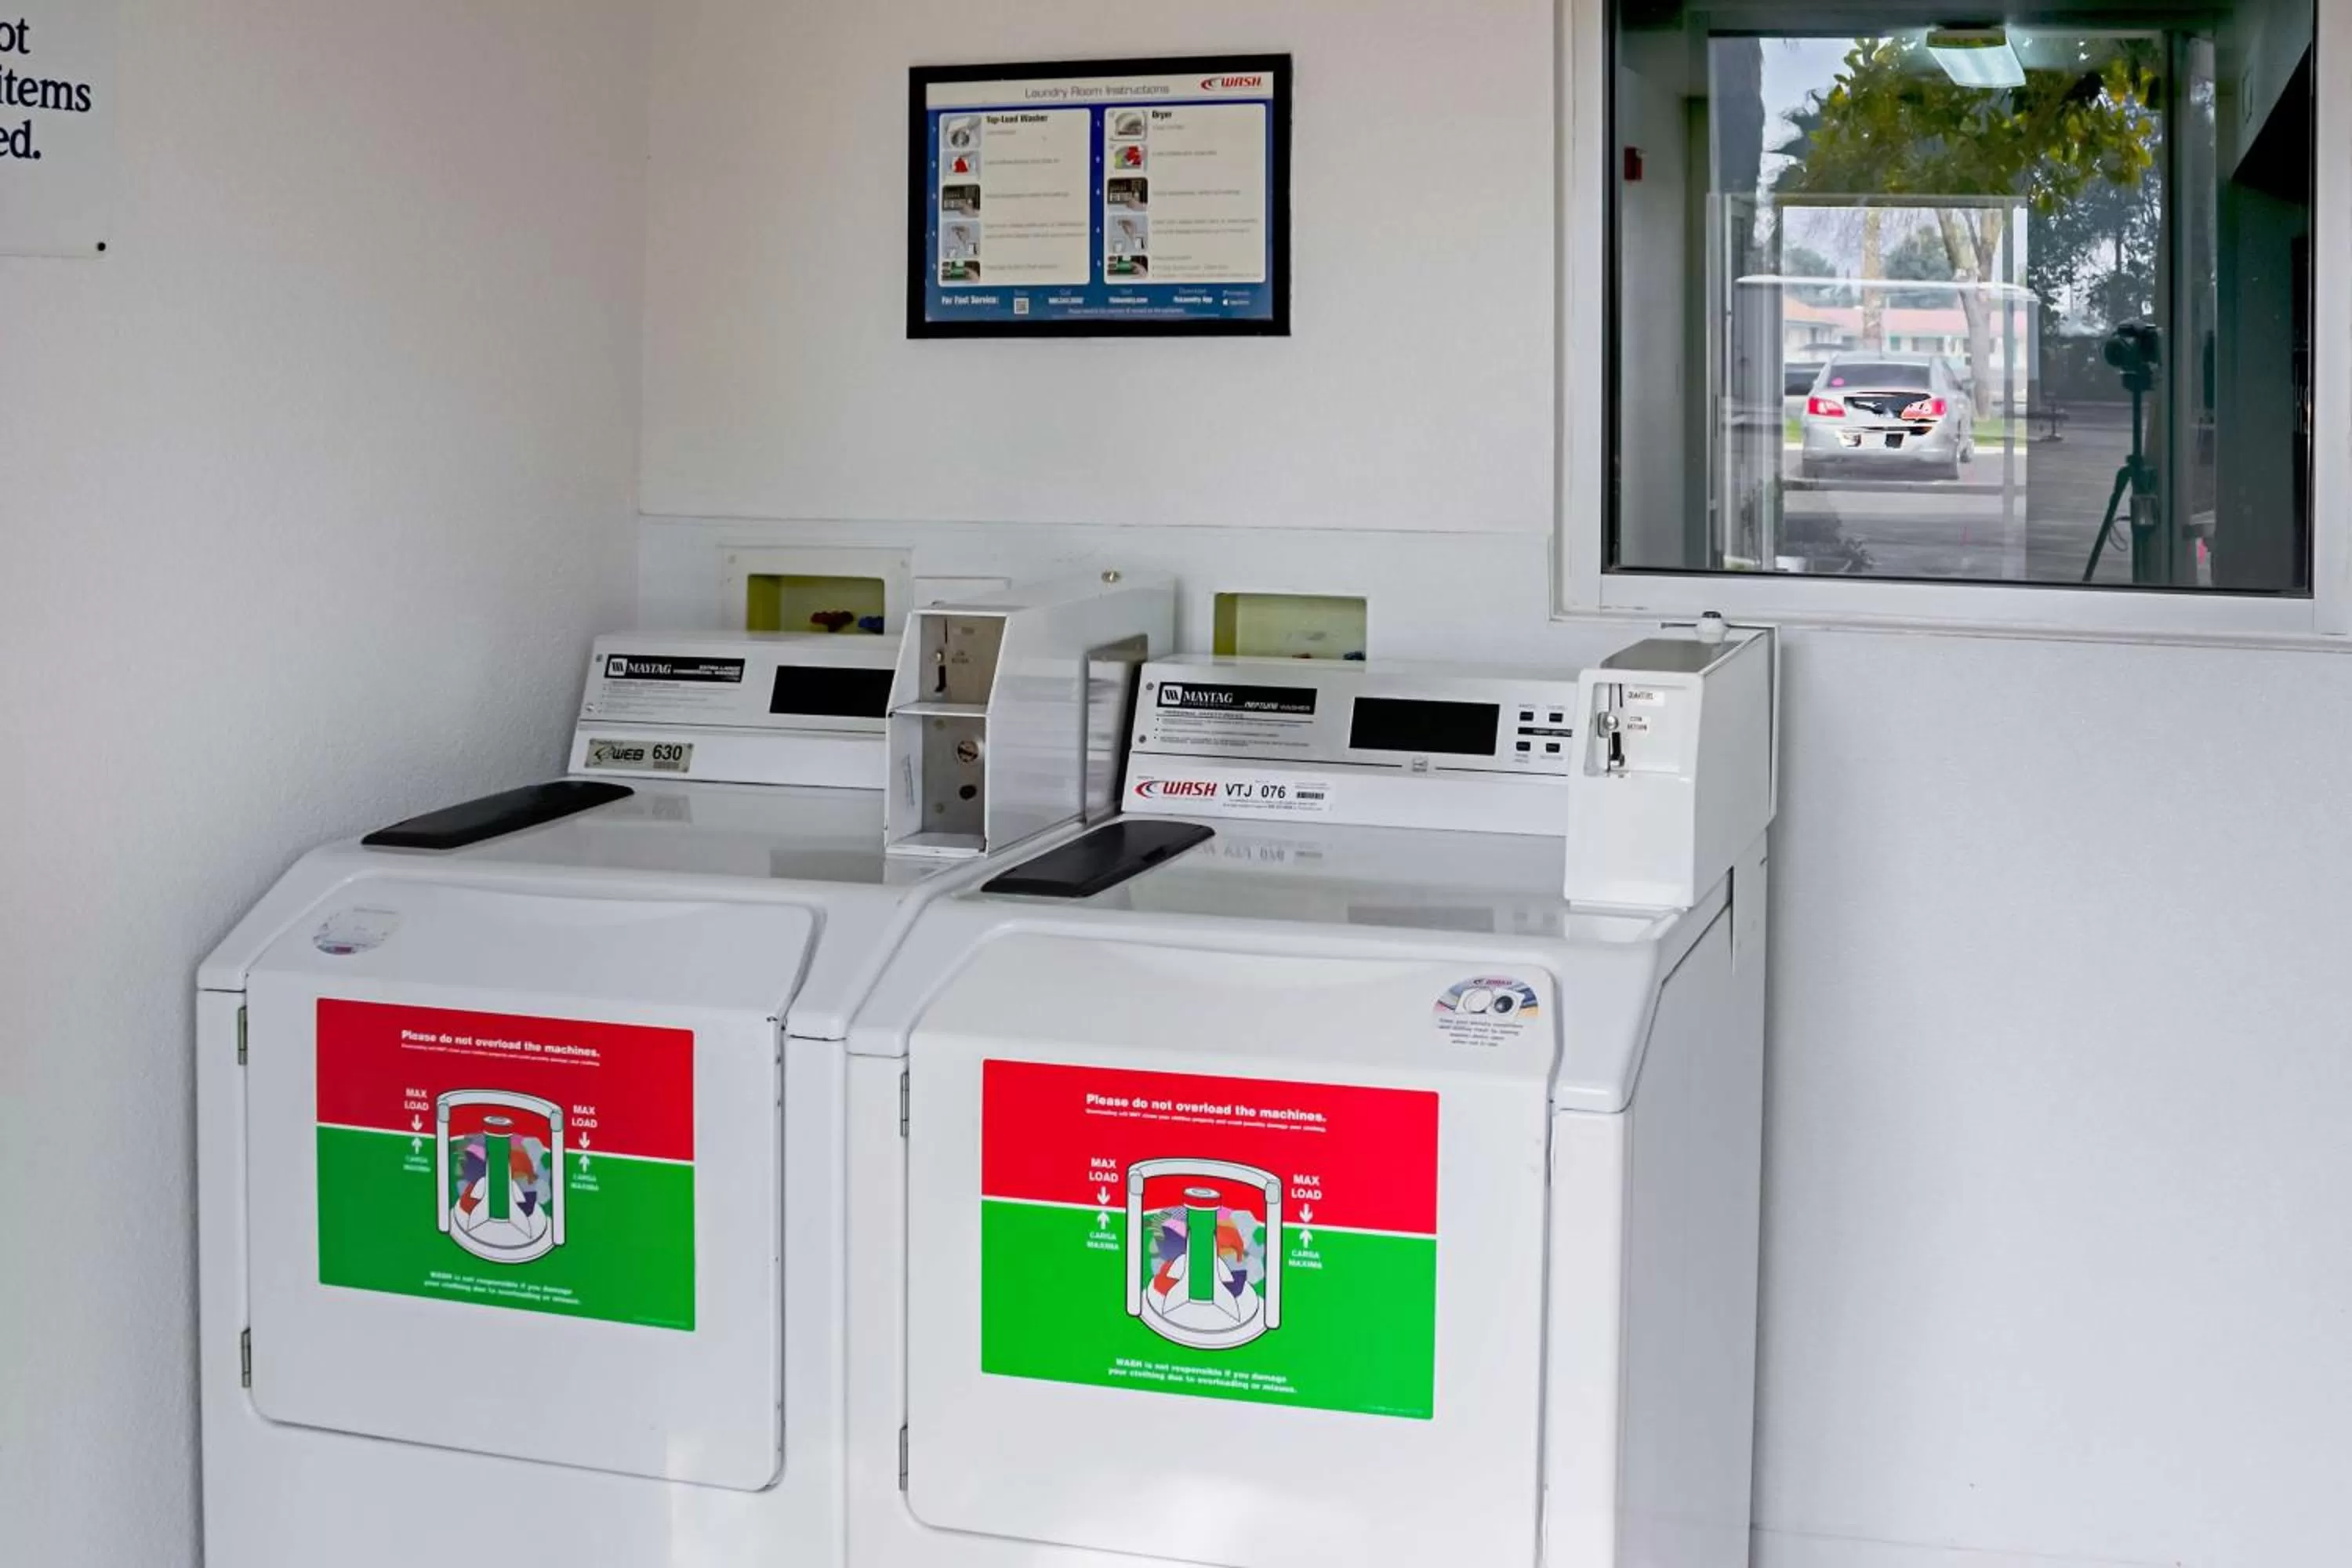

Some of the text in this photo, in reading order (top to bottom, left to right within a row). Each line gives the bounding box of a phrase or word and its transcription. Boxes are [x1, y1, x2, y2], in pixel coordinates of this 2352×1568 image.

[1025, 84, 1170, 99] Laundry Room Instructions
[1152, 110, 1172, 120] Dryer
[627, 662, 672, 675] MAYTAG
[1183, 691, 1234, 703] MAYTAG
[652, 744, 683, 761] 630
[1163, 782, 1217, 797] WASH
[1225, 783, 1252, 797] VTJ
[1261, 785, 1286, 799] 076
[401, 1029, 437, 1042] Please
[440, 1033, 452, 1044] do
[455, 1036, 472, 1046] not
[475, 1039, 521, 1050] overload
[524, 1041, 542, 1052] the
[544, 1045, 601, 1058] machines.
[405, 1088, 427, 1098] MAX
[404, 1100, 429, 1111] LOAD
[573, 1104, 595, 1115] MAX
[1086, 1093, 1327, 1123] Please do not overload the machines.
[572, 1116, 597, 1128] LOAD
[1091, 1157, 1116, 1168] MAX
[1089, 1171, 1119, 1183] LOAD
[1293, 1174, 1319, 1186] MAX
[1291, 1188, 1323, 1200] LOAD
[1116, 1357, 1142, 1368] WASH
[1144, 1361, 1152, 1370] is
[1155, 1363, 1169, 1371] not
[1171, 1365, 1222, 1377] responsible
[1233, 1371, 1249, 1380] you
[1250, 1372, 1287, 1384] damage
[1108, 1367, 1127, 1377] your
[1129, 1370, 1165, 1381] clothing
[1167, 1373, 1183, 1382] due
[1185, 1374, 1195, 1383] to
[1197, 1377, 1249, 1390] overloading
